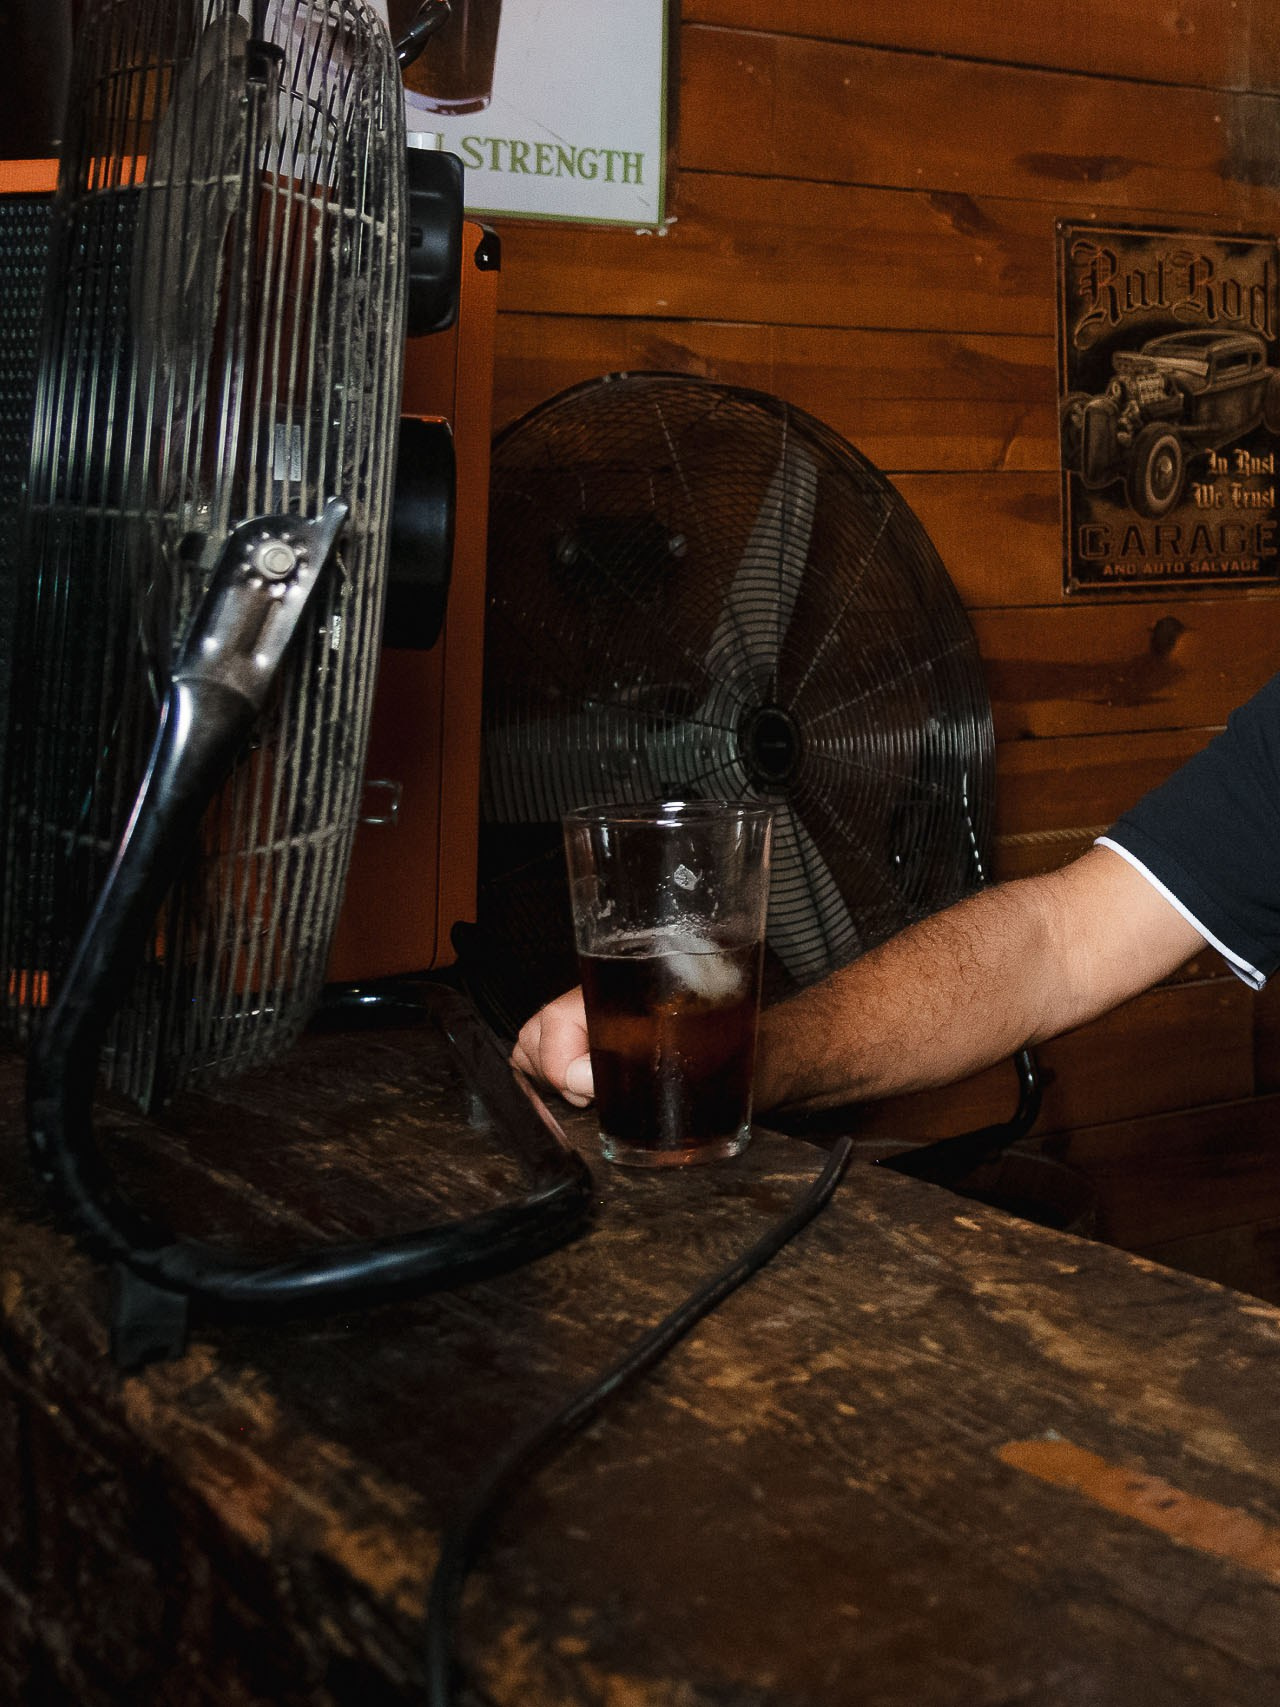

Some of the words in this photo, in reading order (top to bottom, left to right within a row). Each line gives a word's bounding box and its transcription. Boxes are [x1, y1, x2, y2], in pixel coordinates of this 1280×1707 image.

[461, 136, 645, 184] STRENGTH
[1071, 241, 1171, 349] Rat
[1170, 251, 1276, 341] Rod
[1079, 519, 1278, 560] GARAGE
[1103, 562, 1137, 576] AND
[1142, 561, 1186, 574] AUTO
[1190, 559, 1260, 573] SALVAGE
